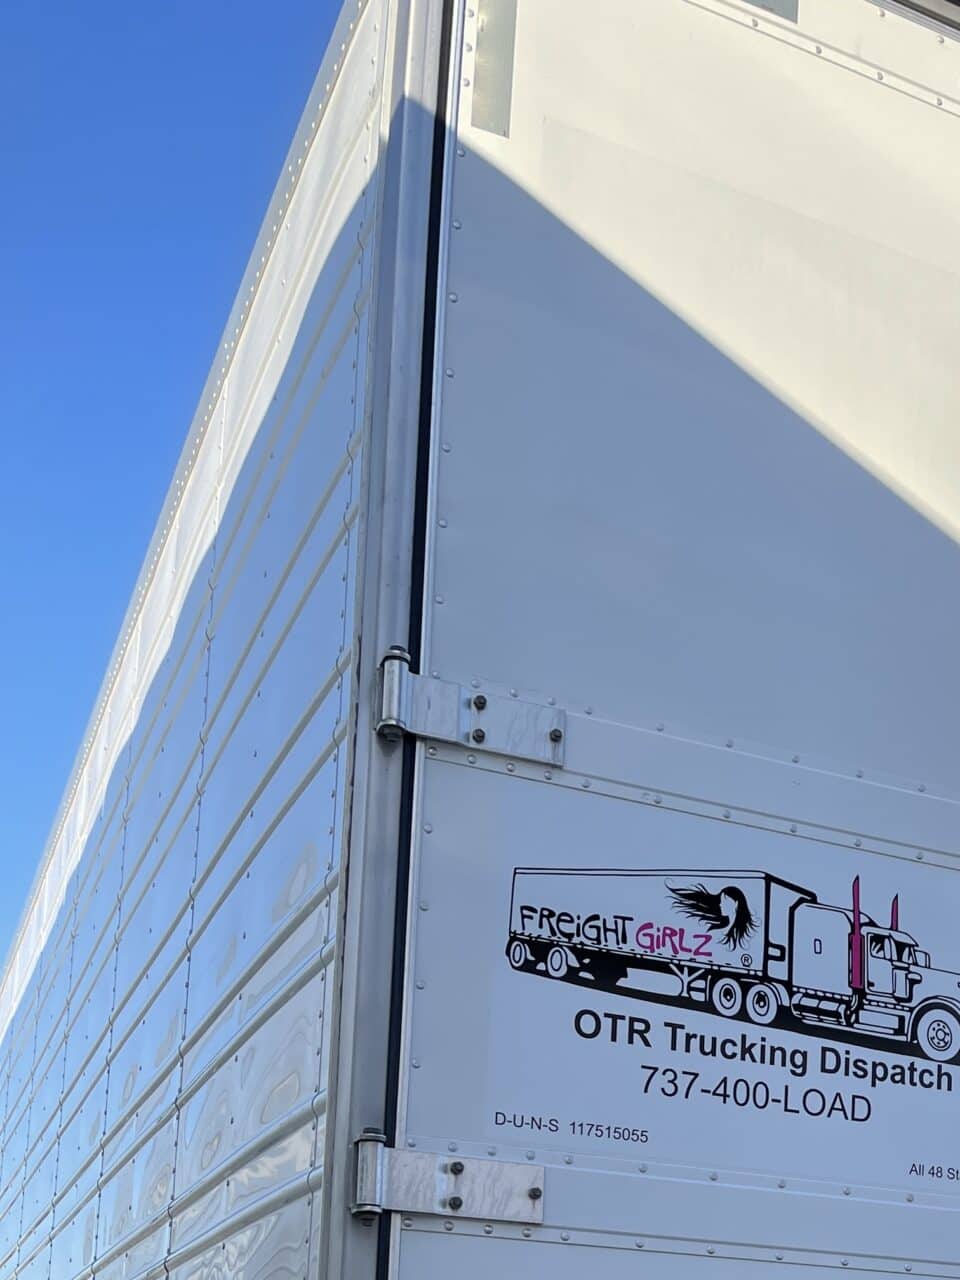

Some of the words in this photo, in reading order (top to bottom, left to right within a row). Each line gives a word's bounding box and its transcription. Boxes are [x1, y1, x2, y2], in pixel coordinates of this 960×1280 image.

[574, 1008, 652, 1048] OTR
[664, 1022, 809, 1076] Trucking
[820, 1046, 954, 1092] Dispatch
[641, 1064, 873, 1123] 737-400-LOAD
[494, 1111, 560, 1133] D-U-N-S
[568, 1121, 649, 1144] 117515055
[909, 1163, 925, 1178] All
[928, 1164, 943, 1179] 48
